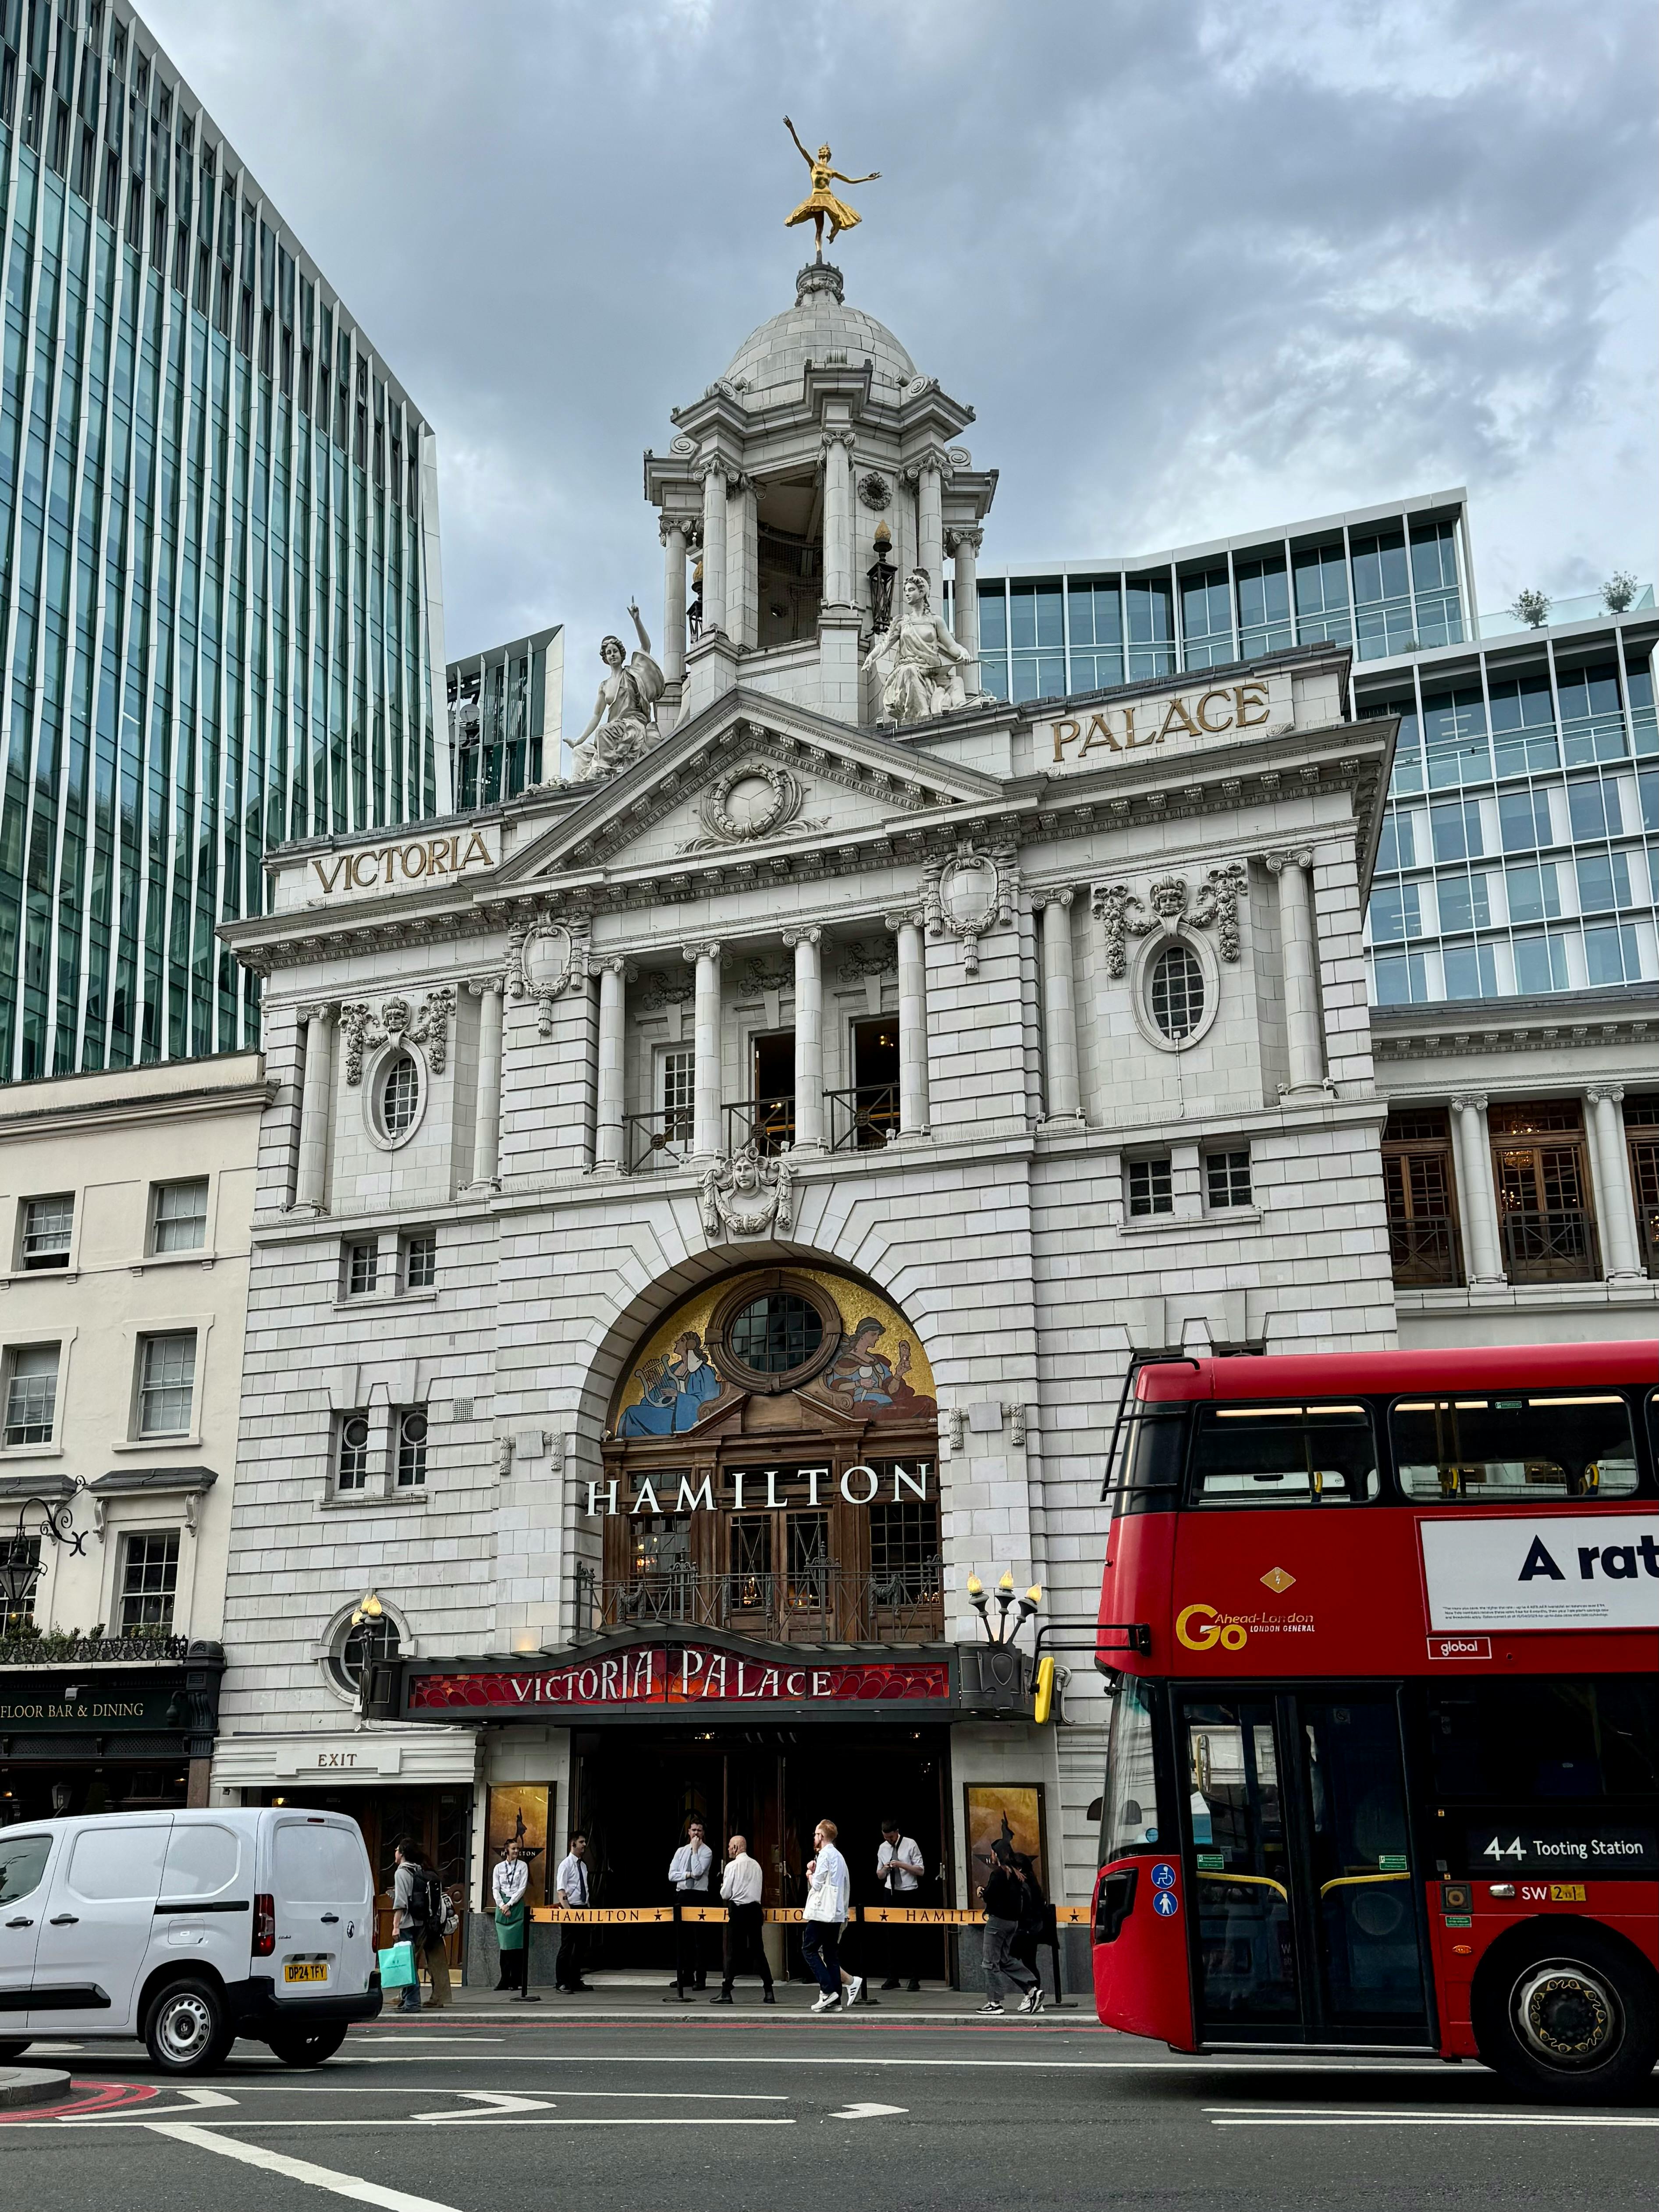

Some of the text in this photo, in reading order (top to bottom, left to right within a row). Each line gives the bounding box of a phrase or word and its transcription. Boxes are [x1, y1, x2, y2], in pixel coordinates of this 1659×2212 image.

[1052, 682, 1270, 762] PALACE
[312, 832, 494, 893] VICTORIA
[585, 1463, 931, 1516] HAMILTON
[1518, 1534, 1566, 1580] A
[1176, 1604, 1313, 1650] Go Ahead-London
[1441, 1640, 1478, 1656] global
[511, 1650, 831, 1701] VICTORIA PALACE
[1, 1703, 144, 1718] FLOOR BAR & DINING
[318, 1754, 357, 1766] EXIT
[1483, 1836, 1643, 1860] 44 Tooting Station
[1522, 1886, 1547, 1900] SW
[551, 1910, 639, 1921] HAMILTON
[289, 1966, 324, 1979] DP24 TFY
